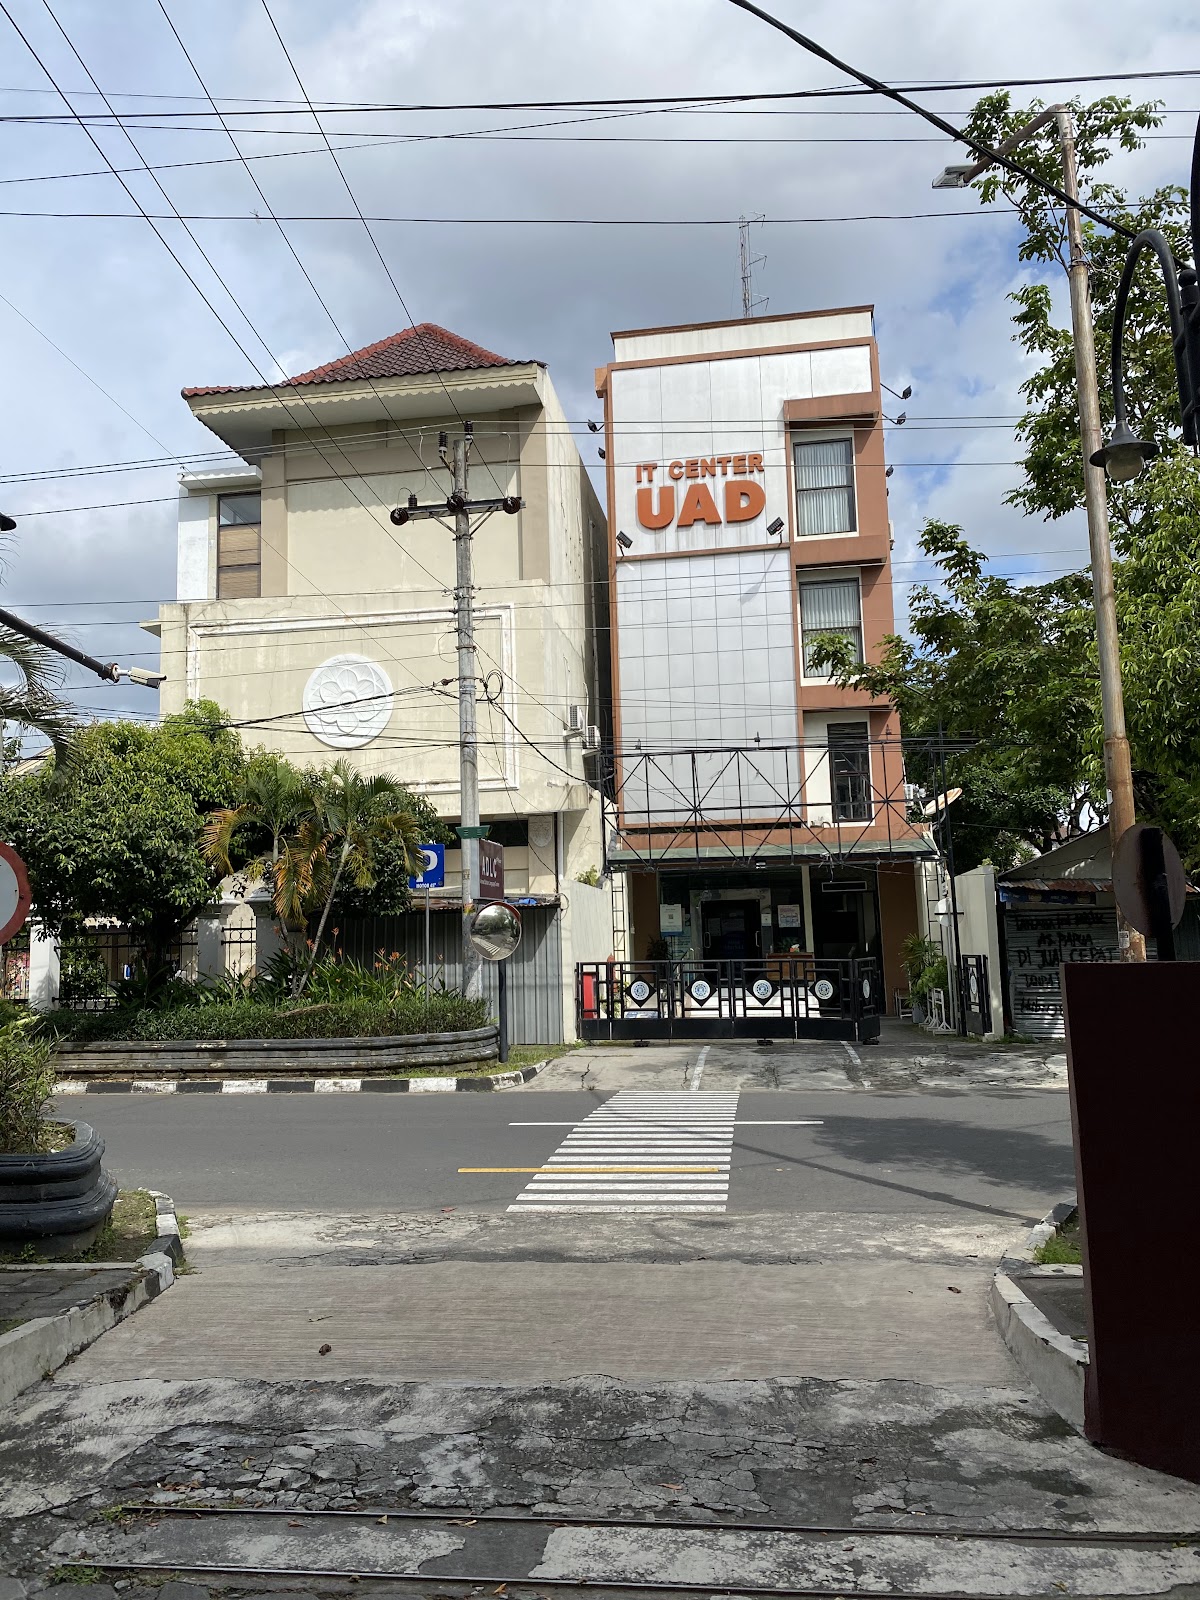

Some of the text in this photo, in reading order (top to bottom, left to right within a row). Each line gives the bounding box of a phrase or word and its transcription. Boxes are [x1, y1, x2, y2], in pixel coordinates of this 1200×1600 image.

[636, 453, 765, 483] IT CENTER
[636, 479, 766, 530] UAD
[481, 855, 497, 879] ADLC
